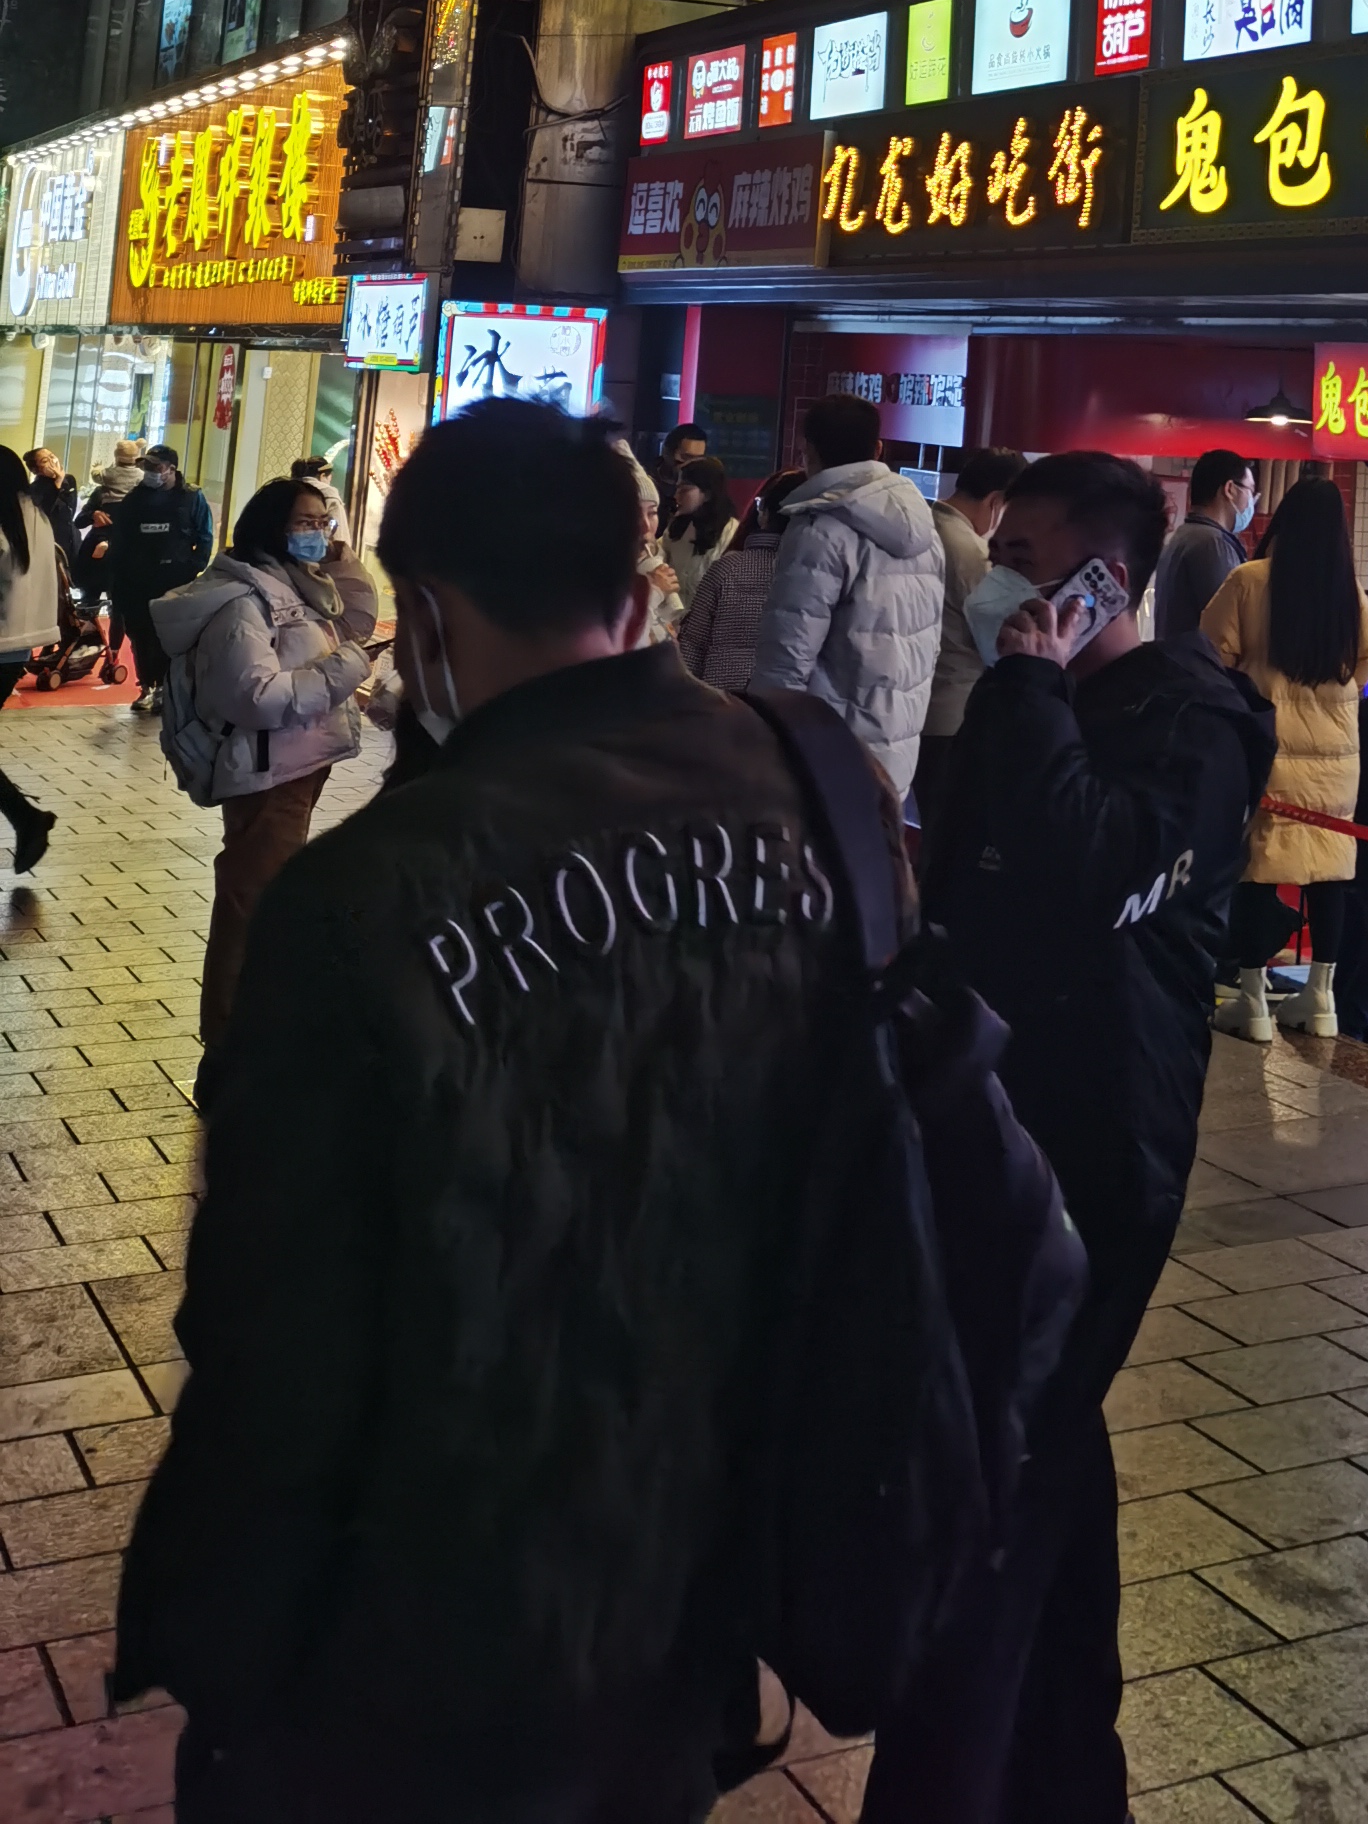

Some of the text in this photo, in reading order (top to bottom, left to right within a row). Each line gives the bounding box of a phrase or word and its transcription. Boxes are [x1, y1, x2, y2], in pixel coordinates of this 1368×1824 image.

[1102, 9, 1146, 58] 葫芦
[163, 90, 310, 259] 老凤祥银楼
[627, 162, 814, 235] 逗喜欢 麻辣炸鸡
